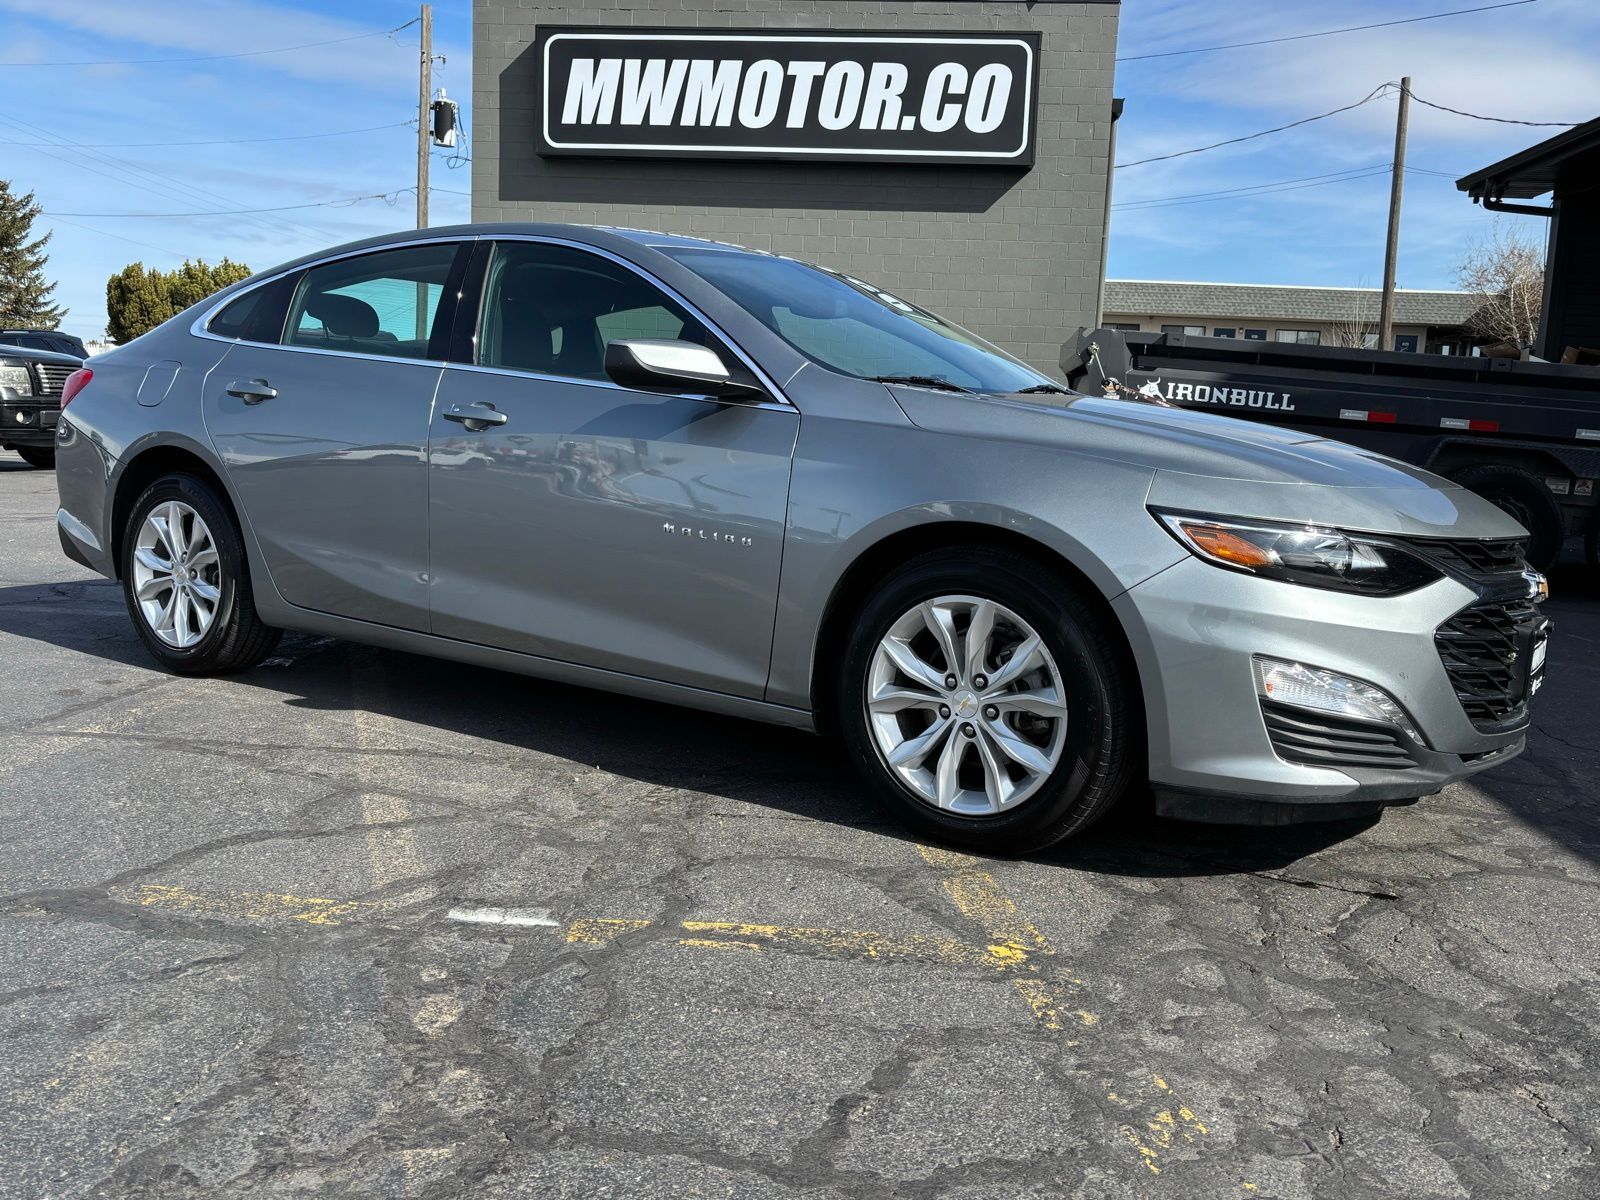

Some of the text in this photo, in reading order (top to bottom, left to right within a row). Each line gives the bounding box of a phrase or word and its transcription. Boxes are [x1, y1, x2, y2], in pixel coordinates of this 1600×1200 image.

[561, 58, 1013, 134] MWMOTOR.CO
[1166, 382, 1295, 411] IRONBULL
[663, 522, 752, 546] MALIBU
